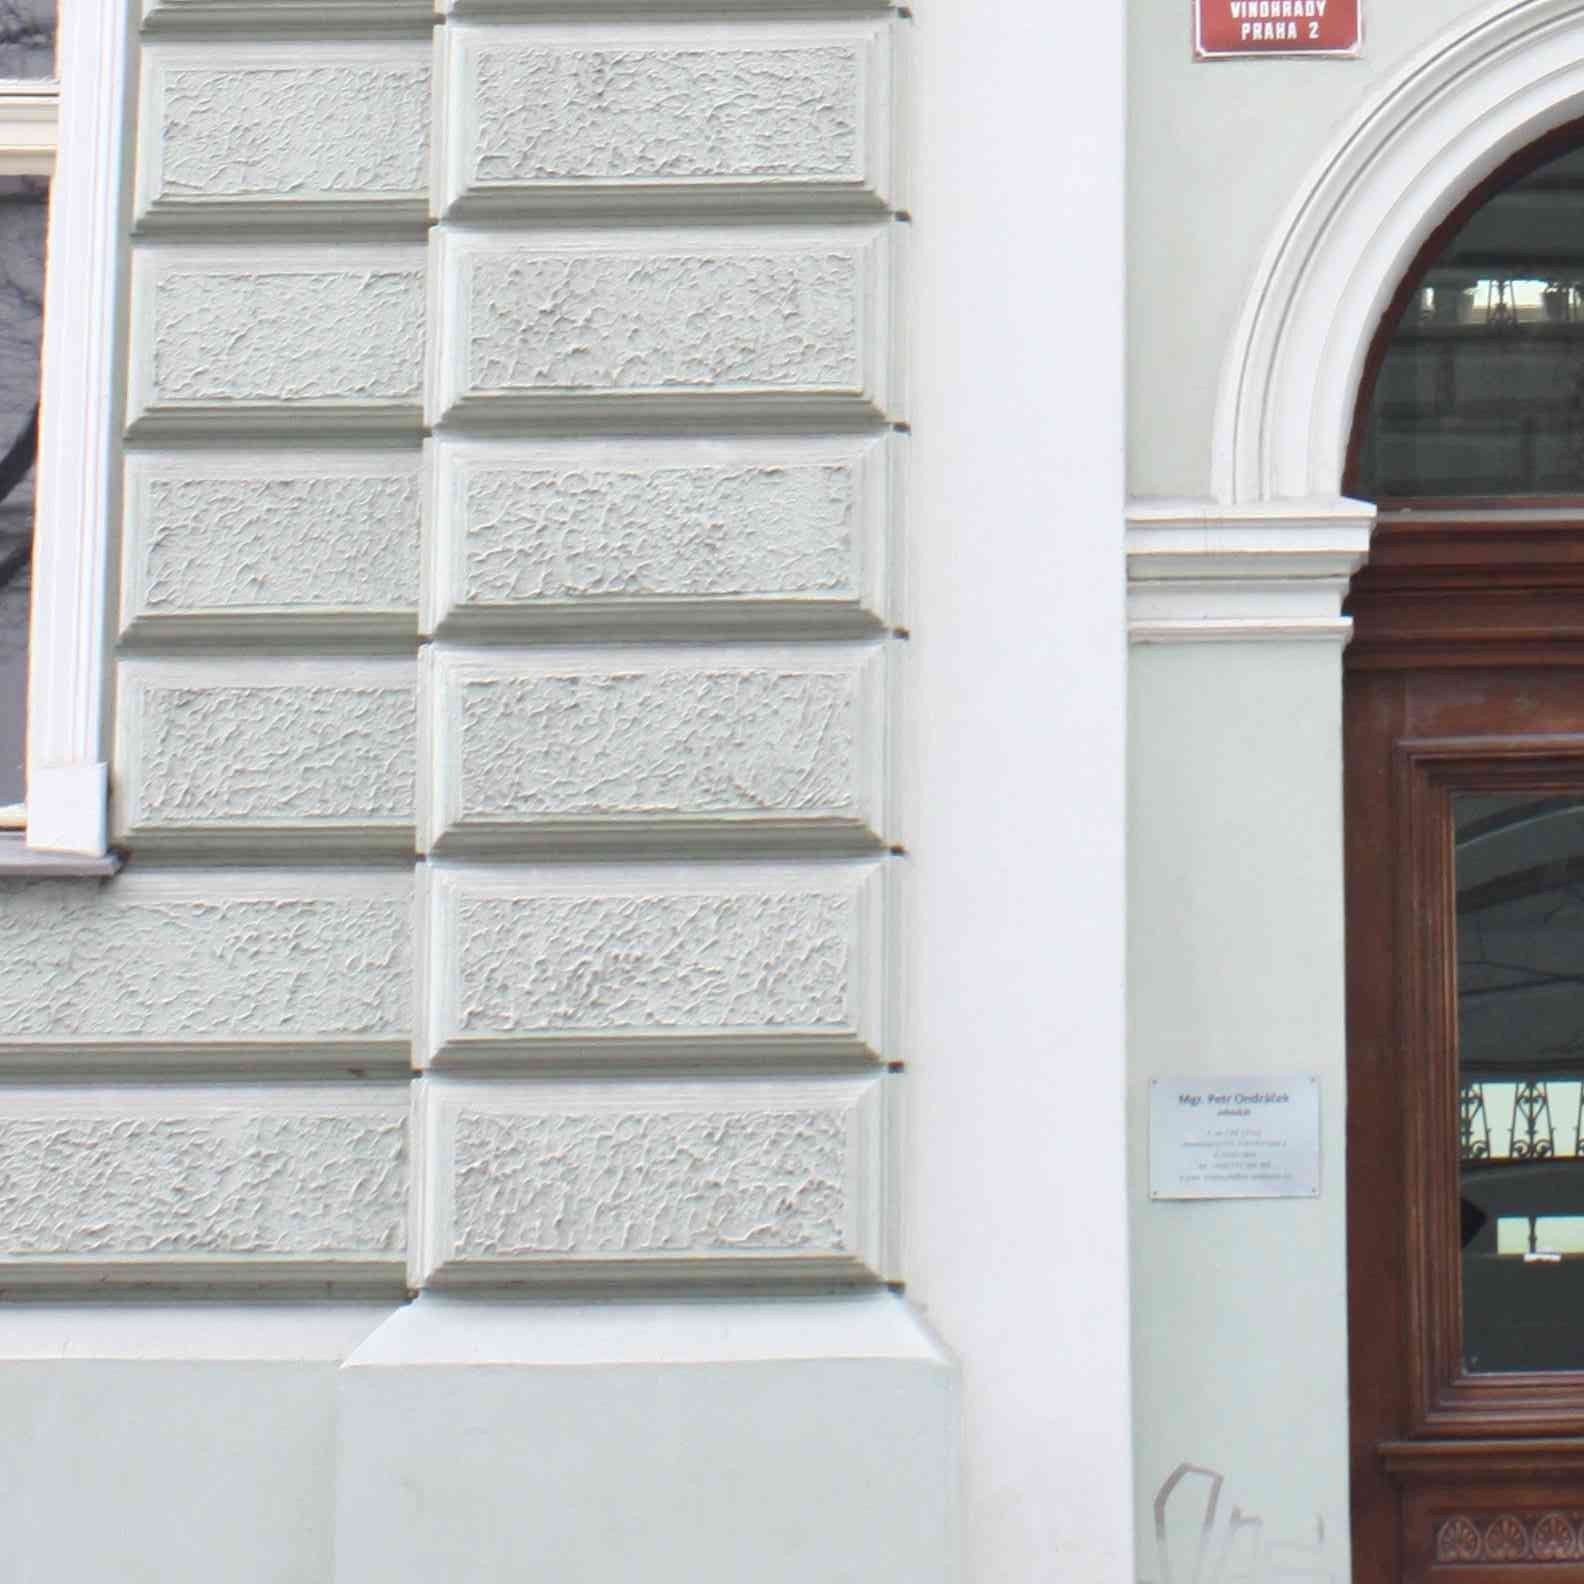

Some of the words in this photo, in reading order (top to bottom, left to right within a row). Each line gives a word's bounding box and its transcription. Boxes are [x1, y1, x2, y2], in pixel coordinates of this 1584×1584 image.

[1230, 0, 1327, 19] VINOHRADY
[1241, 22, 1297, 41] PRAHA
[1308, 22, 1320, 39] 2
